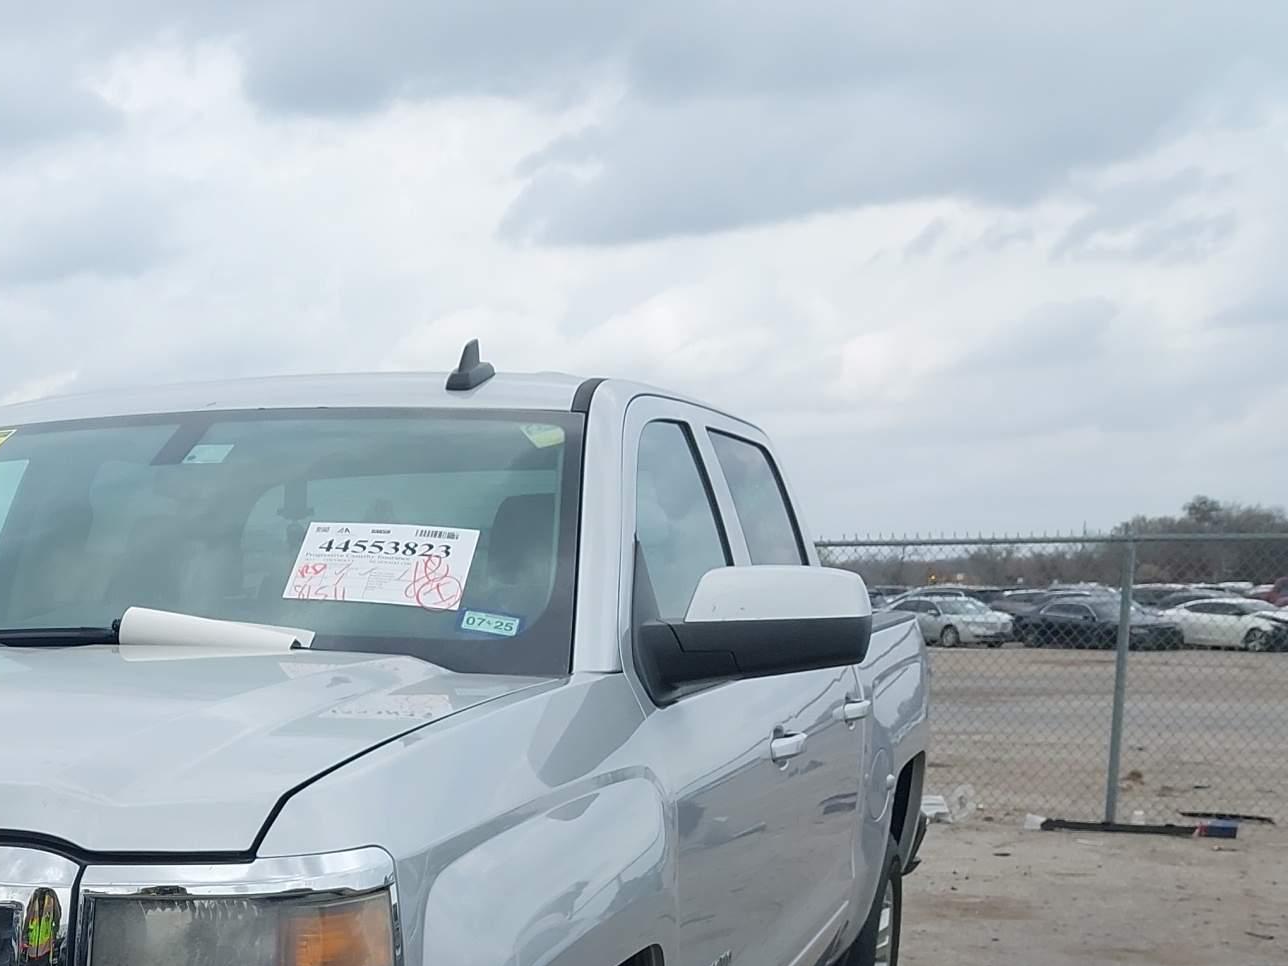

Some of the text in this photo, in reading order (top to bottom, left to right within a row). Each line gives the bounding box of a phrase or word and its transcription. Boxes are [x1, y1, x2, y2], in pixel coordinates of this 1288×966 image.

[318, 538, 452, 559] 44553823
[465, 616, 514, 632] 07 25
